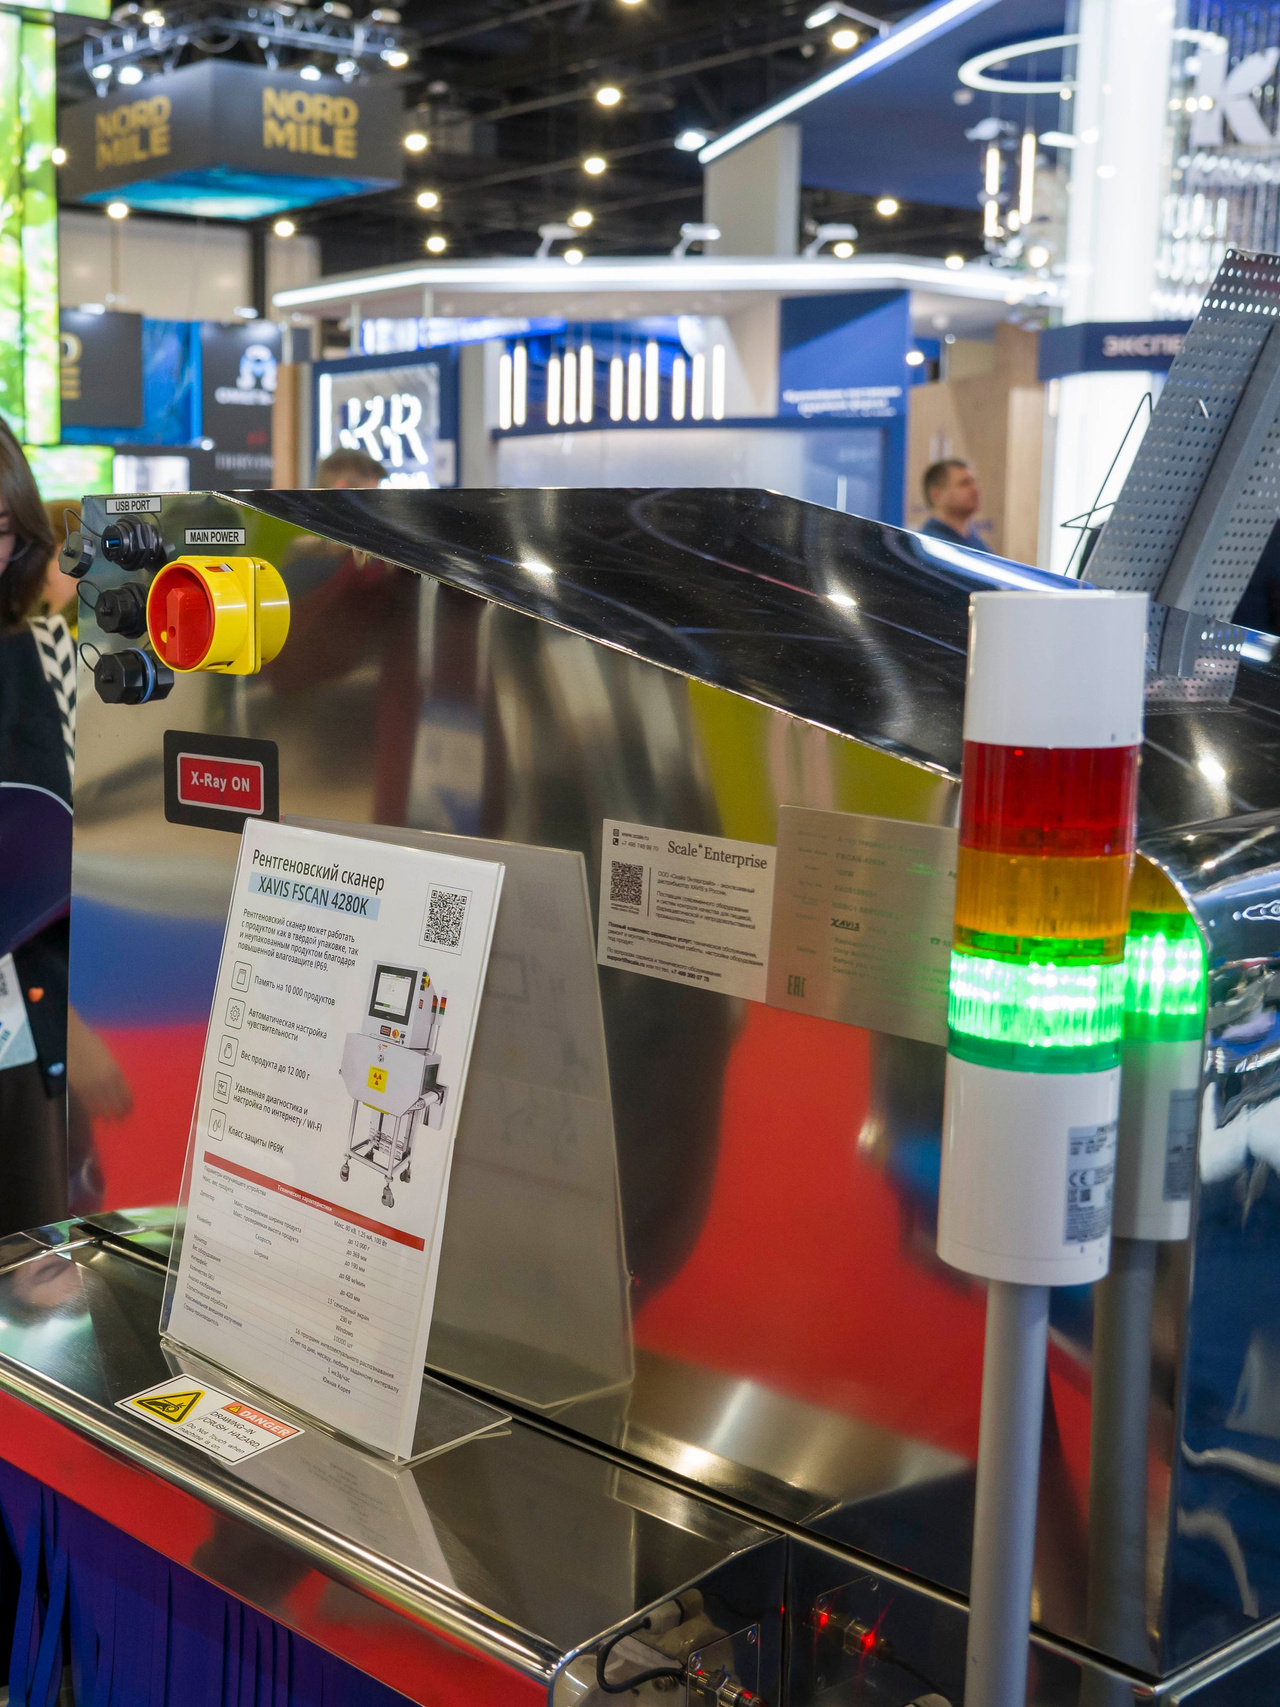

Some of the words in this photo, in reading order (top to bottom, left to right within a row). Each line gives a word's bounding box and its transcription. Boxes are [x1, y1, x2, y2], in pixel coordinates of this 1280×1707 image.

[96, 95, 171, 138] NORD
[263, 87, 359, 127] NORD
[96, 127, 170, 170] MILE
[263, 119, 358, 159] MILE
[115, 501, 130, 512] USB
[132, 499, 150, 511] PORT
[190, 531, 209, 542] MAIN
[211, 531, 239, 543] POWER
[191, 770, 227, 792] X-Ray
[232, 776, 250, 793] ON
[251, 847, 339, 882] Рентгеновский
[340, 869, 385, 895] сканер
[703, 845, 768, 873] Enterprise
[257, 875, 290, 898] XAVIS
[291, 882, 329, 907] FSCAN
[330, 891, 369, 916] 4280K
[242, 908, 285, 926] Рентгеновский
[284, 919, 306, 933] сканер
[326, 927, 355, 945] работать
[244, 921, 275, 937] продуктом
[291, 930, 317, 946] твердой
[316, 938, 347, 954] упаковке,
[830, 917, 860, 932] XAVIS
[237, 940, 275, 958] повышенной
[274, 951, 313, 969] влагозащите
[244, 932, 290, 951] неупакованным
[290, 943, 323, 959] продуктом
[322, 950, 355, 968] благодаря
[302, 990, 335, 1008] продуктов
[245, 1018, 298, 1042] чувствительности
[247, 1007, 295, 1029] Автоматическая
[295, 1021, 327, 1041] настройка
[250, 1055, 277, 1071] продукта
[232, 1093, 263, 1112] настройка
[270, 1107, 302, 1127] интернету
[234, 1082, 265, 1100] Удаленная
[265, 1094, 303, 1114] диагностика
[243, 1132, 267, 1149] защиты
[176, 1426, 205, 1441] machine
[209, 1411, 257, 1434] DRAWING-IN
[237, 1410, 291, 1436] DANGER
